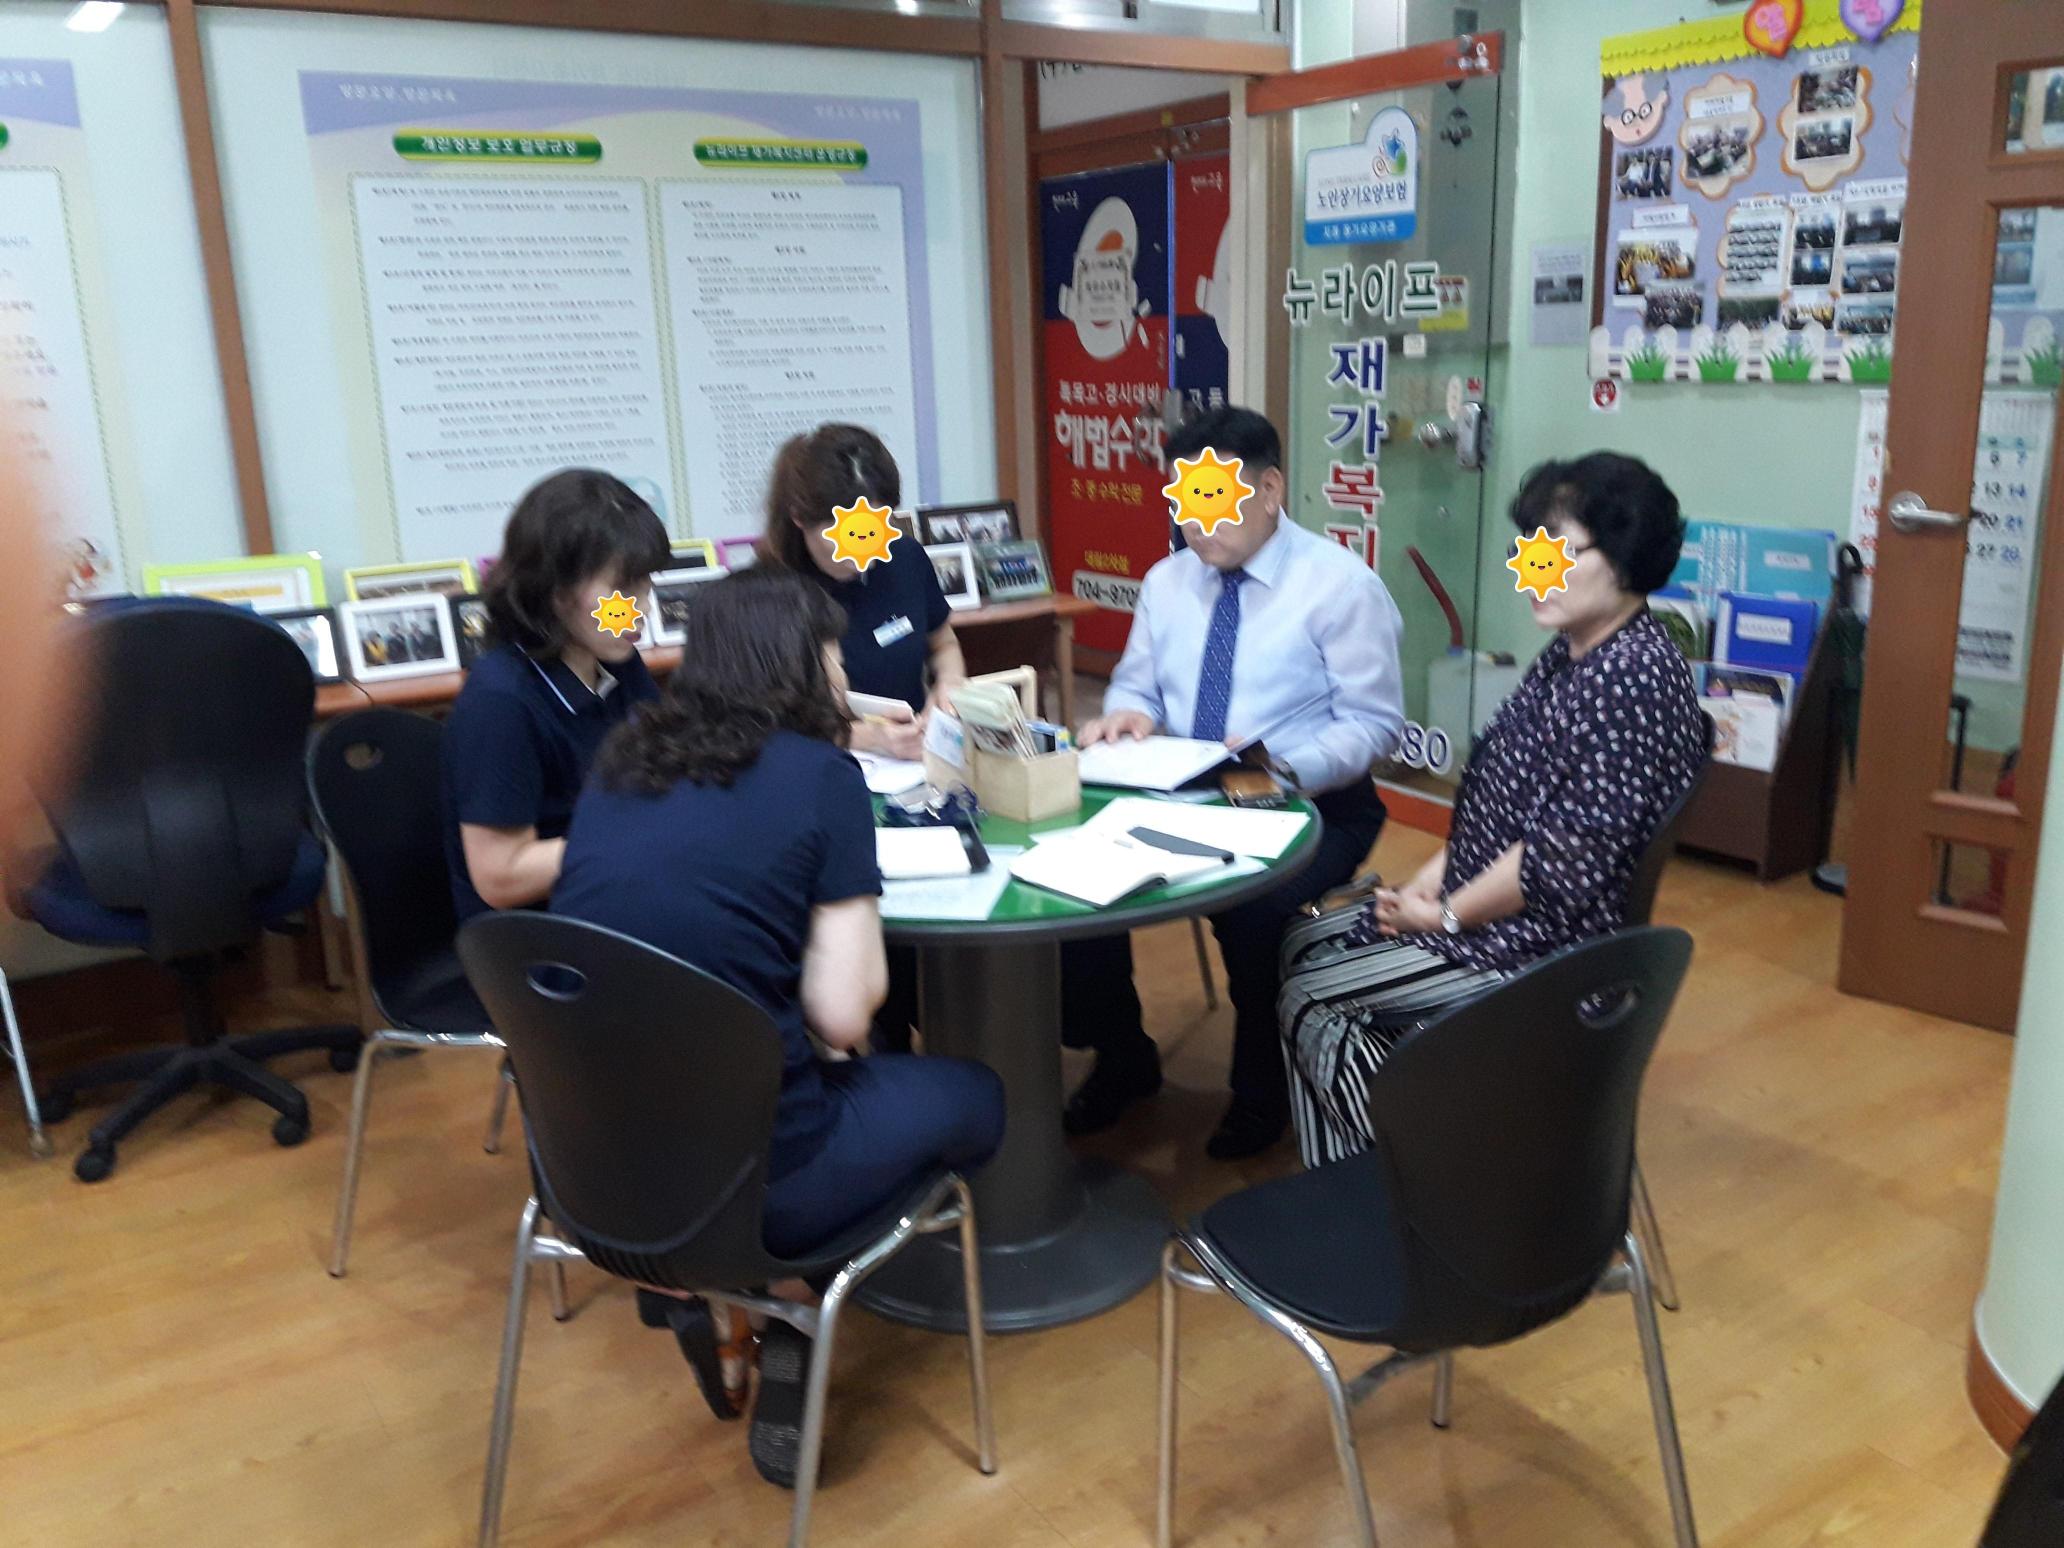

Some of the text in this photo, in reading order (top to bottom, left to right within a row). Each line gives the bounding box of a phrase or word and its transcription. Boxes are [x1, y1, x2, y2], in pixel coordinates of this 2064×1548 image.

[1284, 258, 1442, 328] 뉴라이프
[1054, 409, 1168, 475] 해법수학
[1076, 577, 1141, 609] 704-970
[1399, 722, 1453, 776] 80
